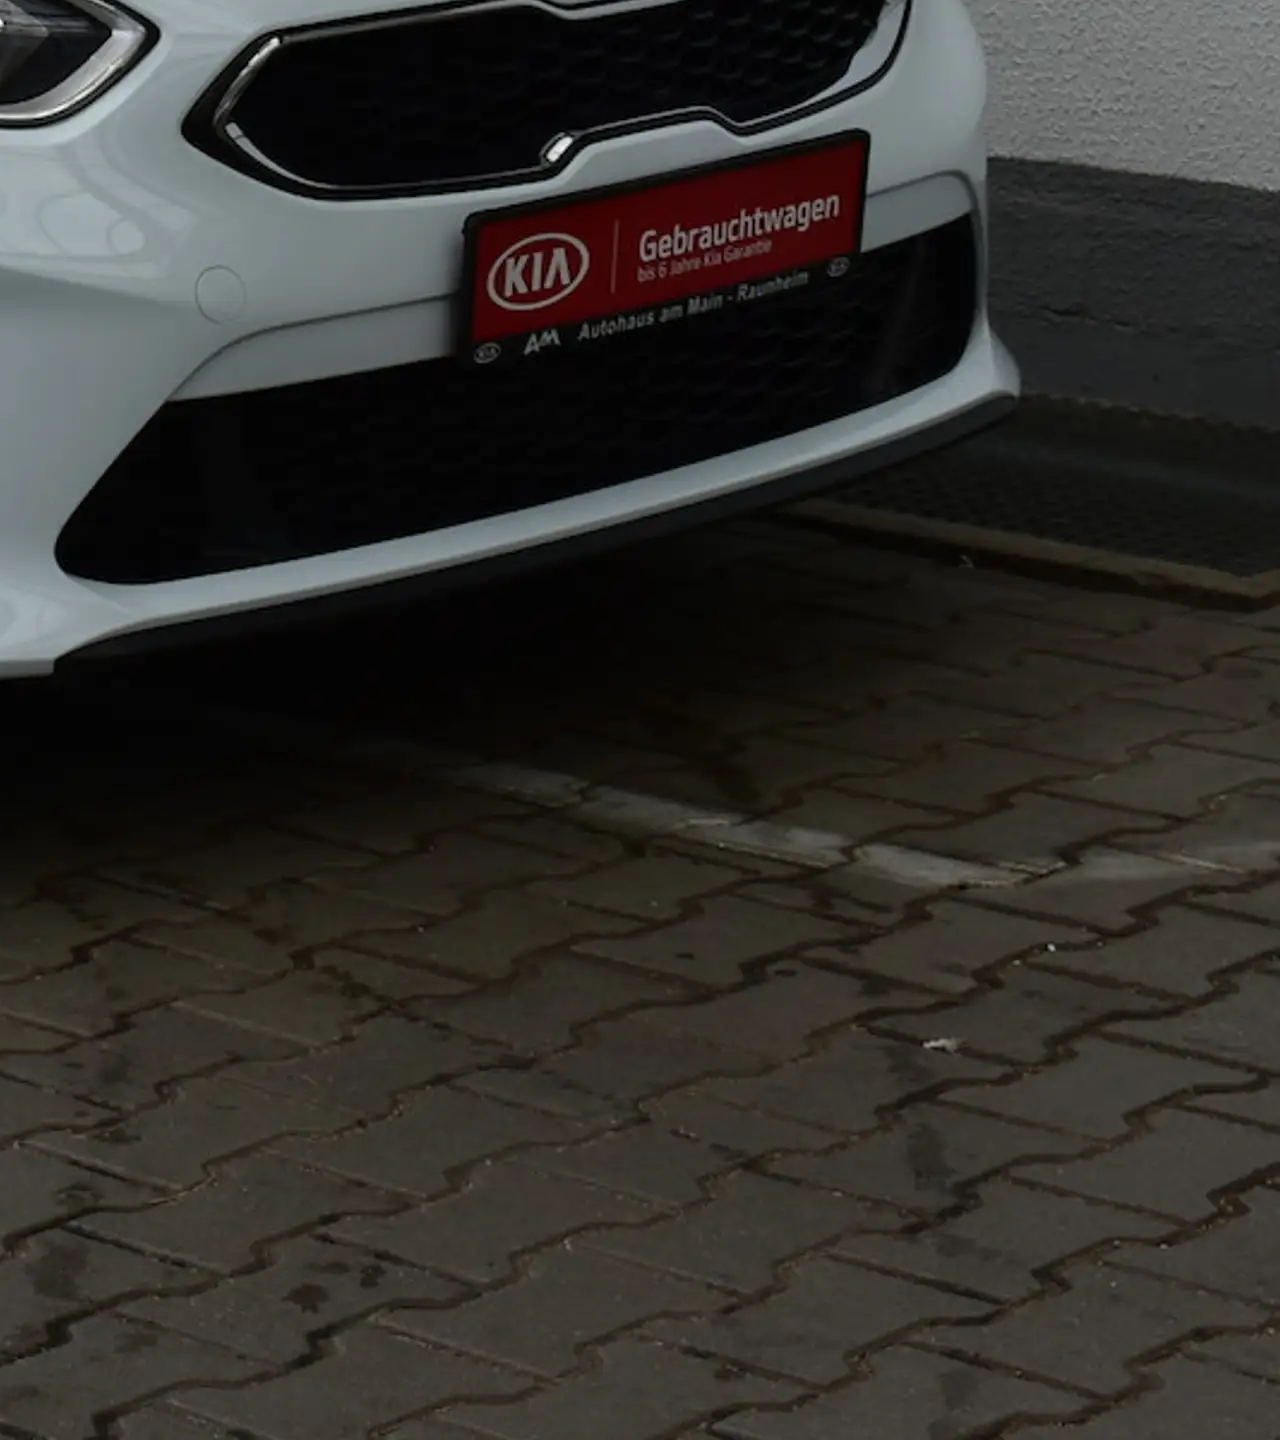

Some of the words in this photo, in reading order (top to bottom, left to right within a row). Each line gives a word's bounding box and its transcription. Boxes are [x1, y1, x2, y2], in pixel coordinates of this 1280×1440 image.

[639, 194, 840, 262] Gebrauchtwagen
[504, 247, 571, 298] KIA
[576, 311, 656, 342] Autohaus
[659, 303, 683, 322] am
[686, 291, 724, 316] Main
[736, 268, 810, 303] Raunheim
